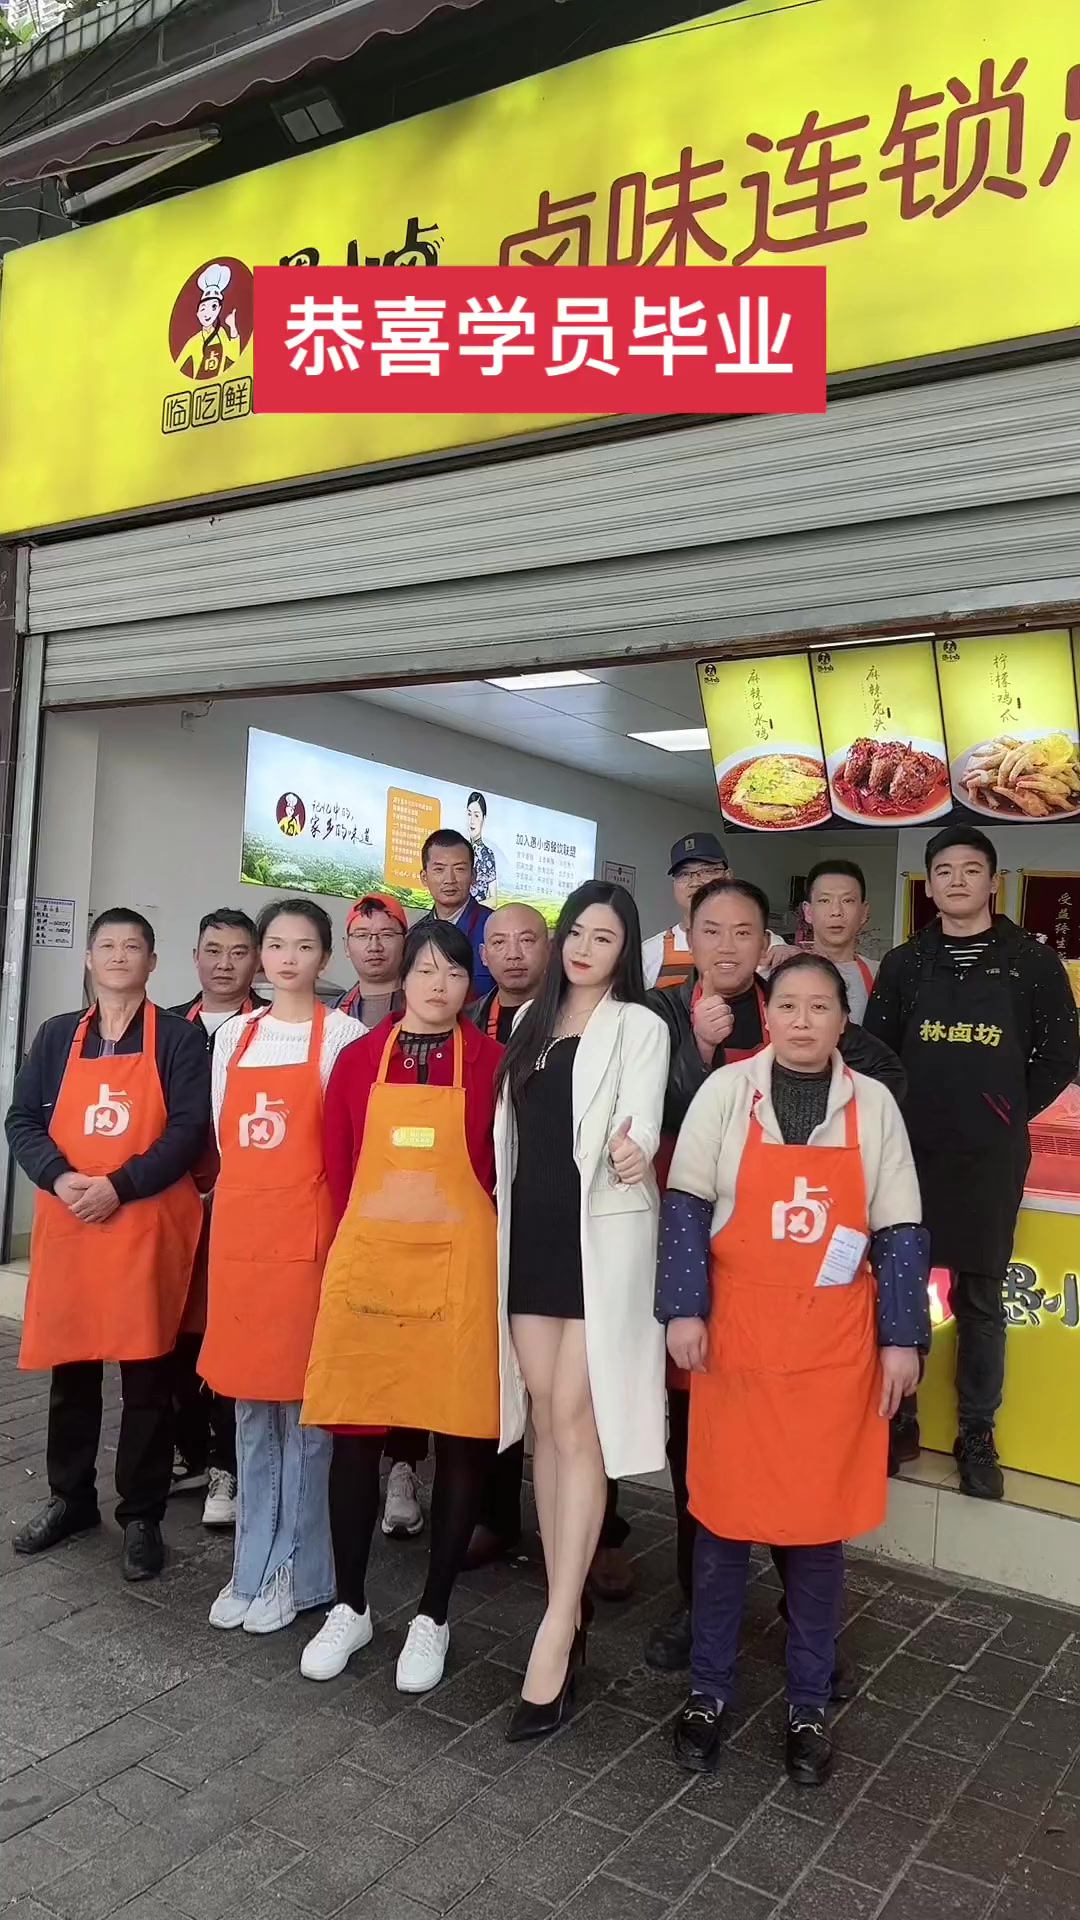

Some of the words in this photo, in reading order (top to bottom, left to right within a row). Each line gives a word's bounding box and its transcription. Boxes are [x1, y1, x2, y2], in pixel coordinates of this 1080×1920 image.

[164, 380, 250, 430] 临吃鲜
[747, 668, 769, 741] 麻辣口水鸡
[992, 653, 1018, 723] 柠檬鸡爪
[309, 814, 374, 846] 家乡的味道
[919, 1018, 1003, 1047] 林卤坊
